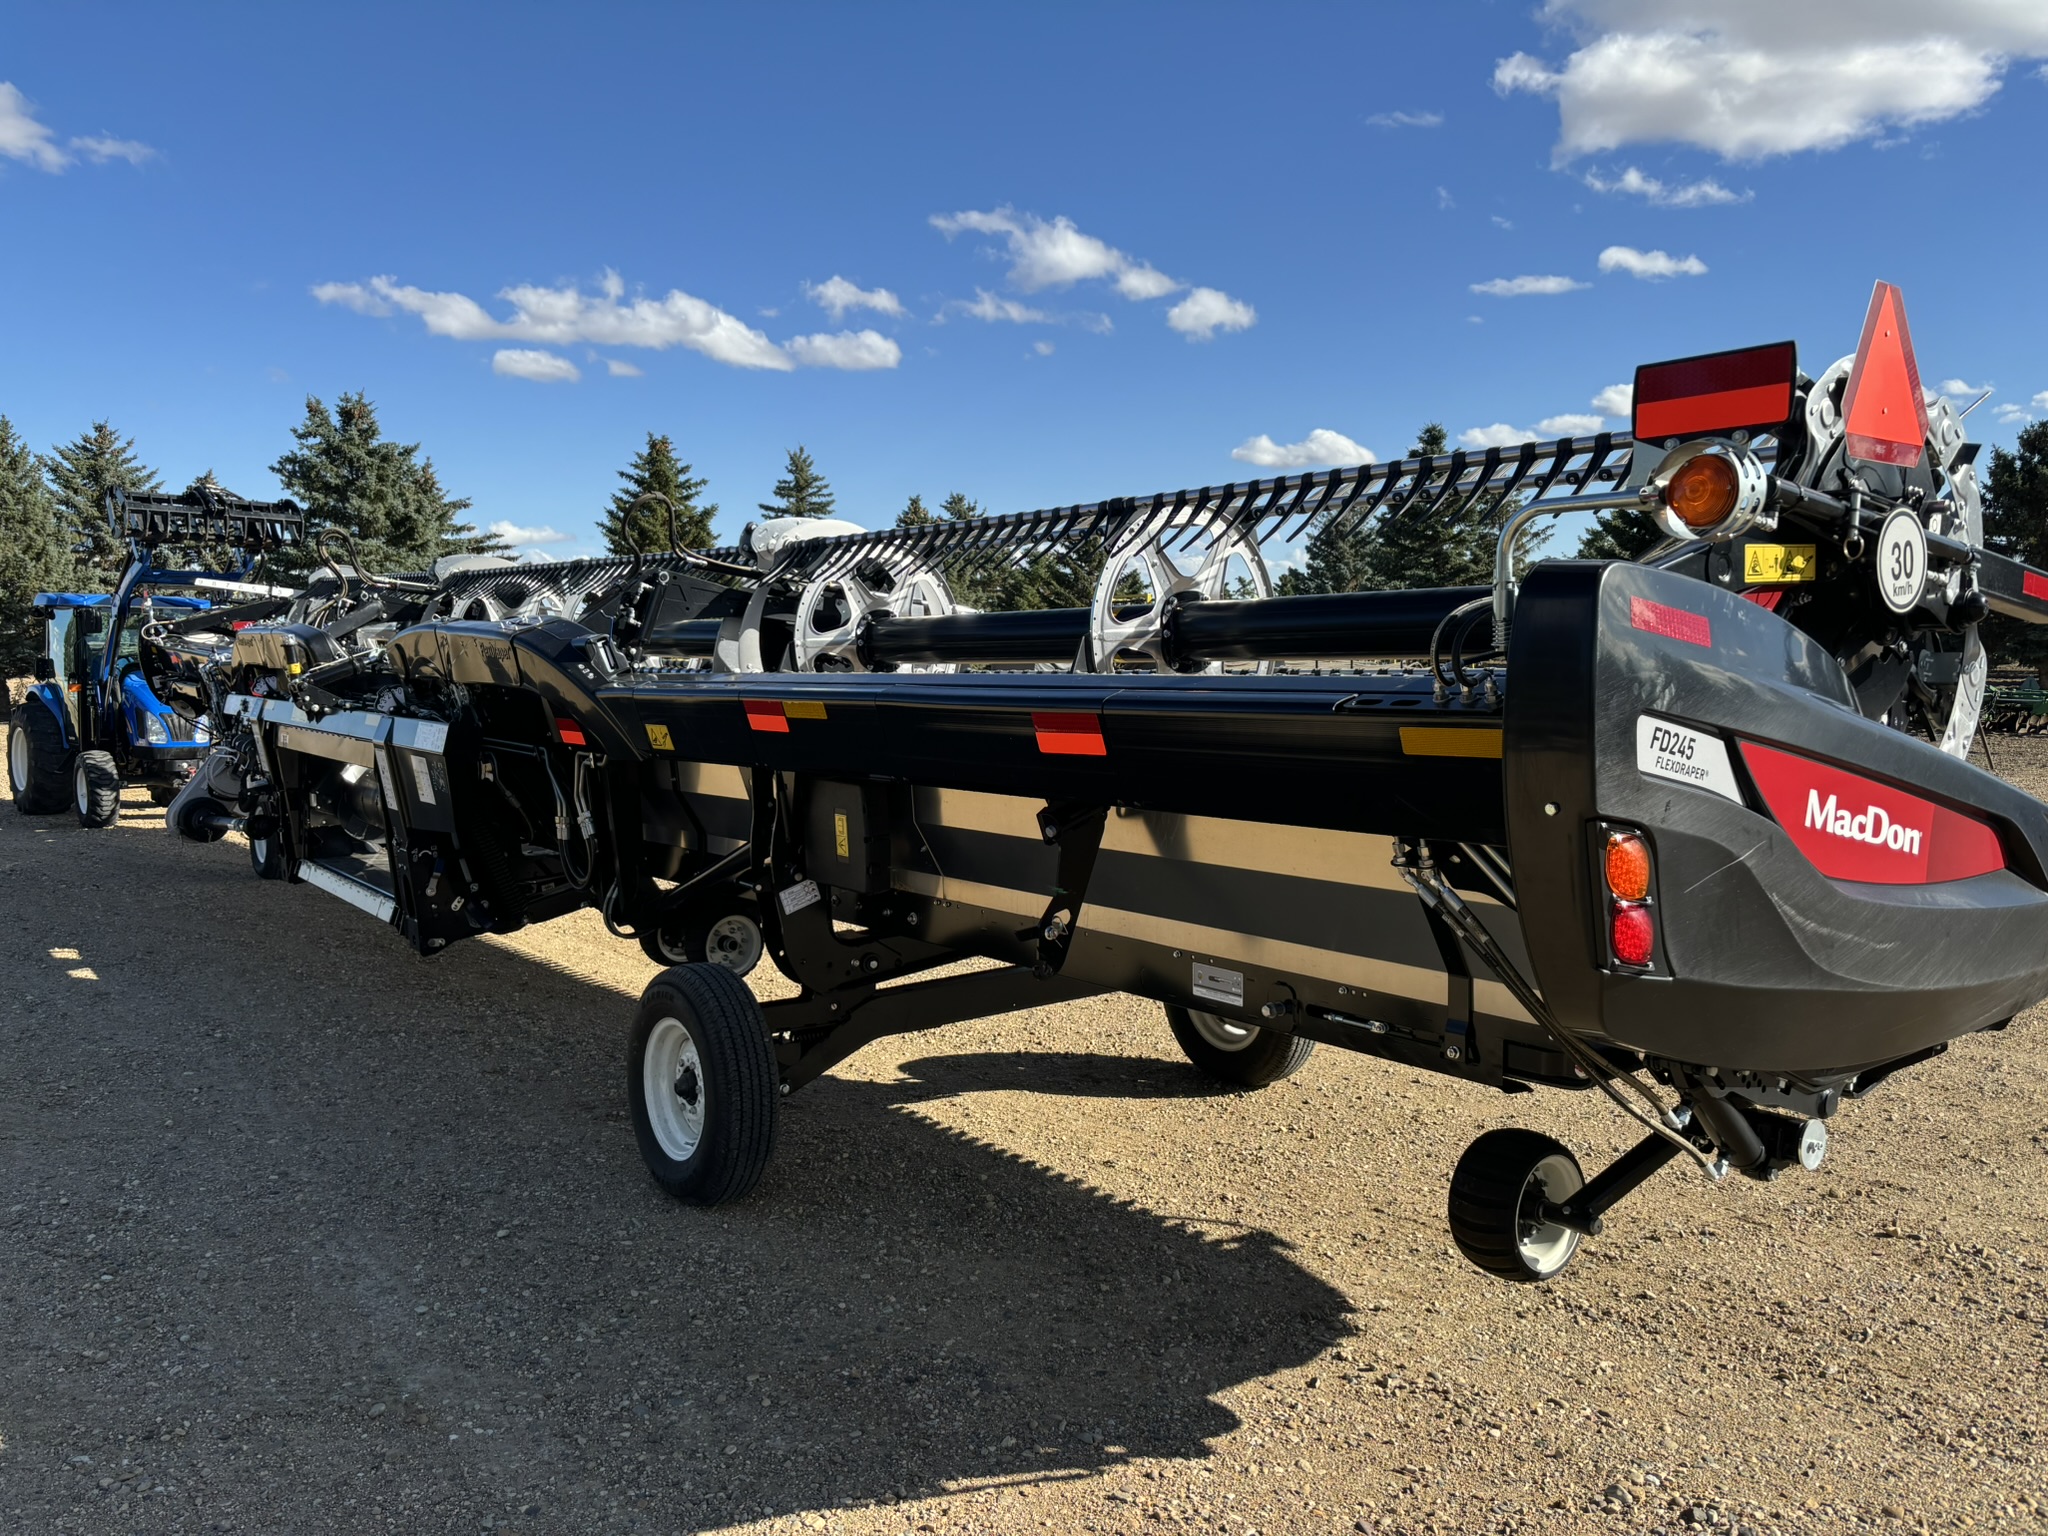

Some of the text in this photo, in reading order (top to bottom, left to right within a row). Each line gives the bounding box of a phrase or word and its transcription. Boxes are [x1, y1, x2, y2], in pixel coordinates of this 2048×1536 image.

[1891, 540, 1914, 581] 30
[1892, 581, 1913, 598] km/h
[1649, 726, 1697, 761] FD245
[1804, 788, 1921, 855] MacDon
